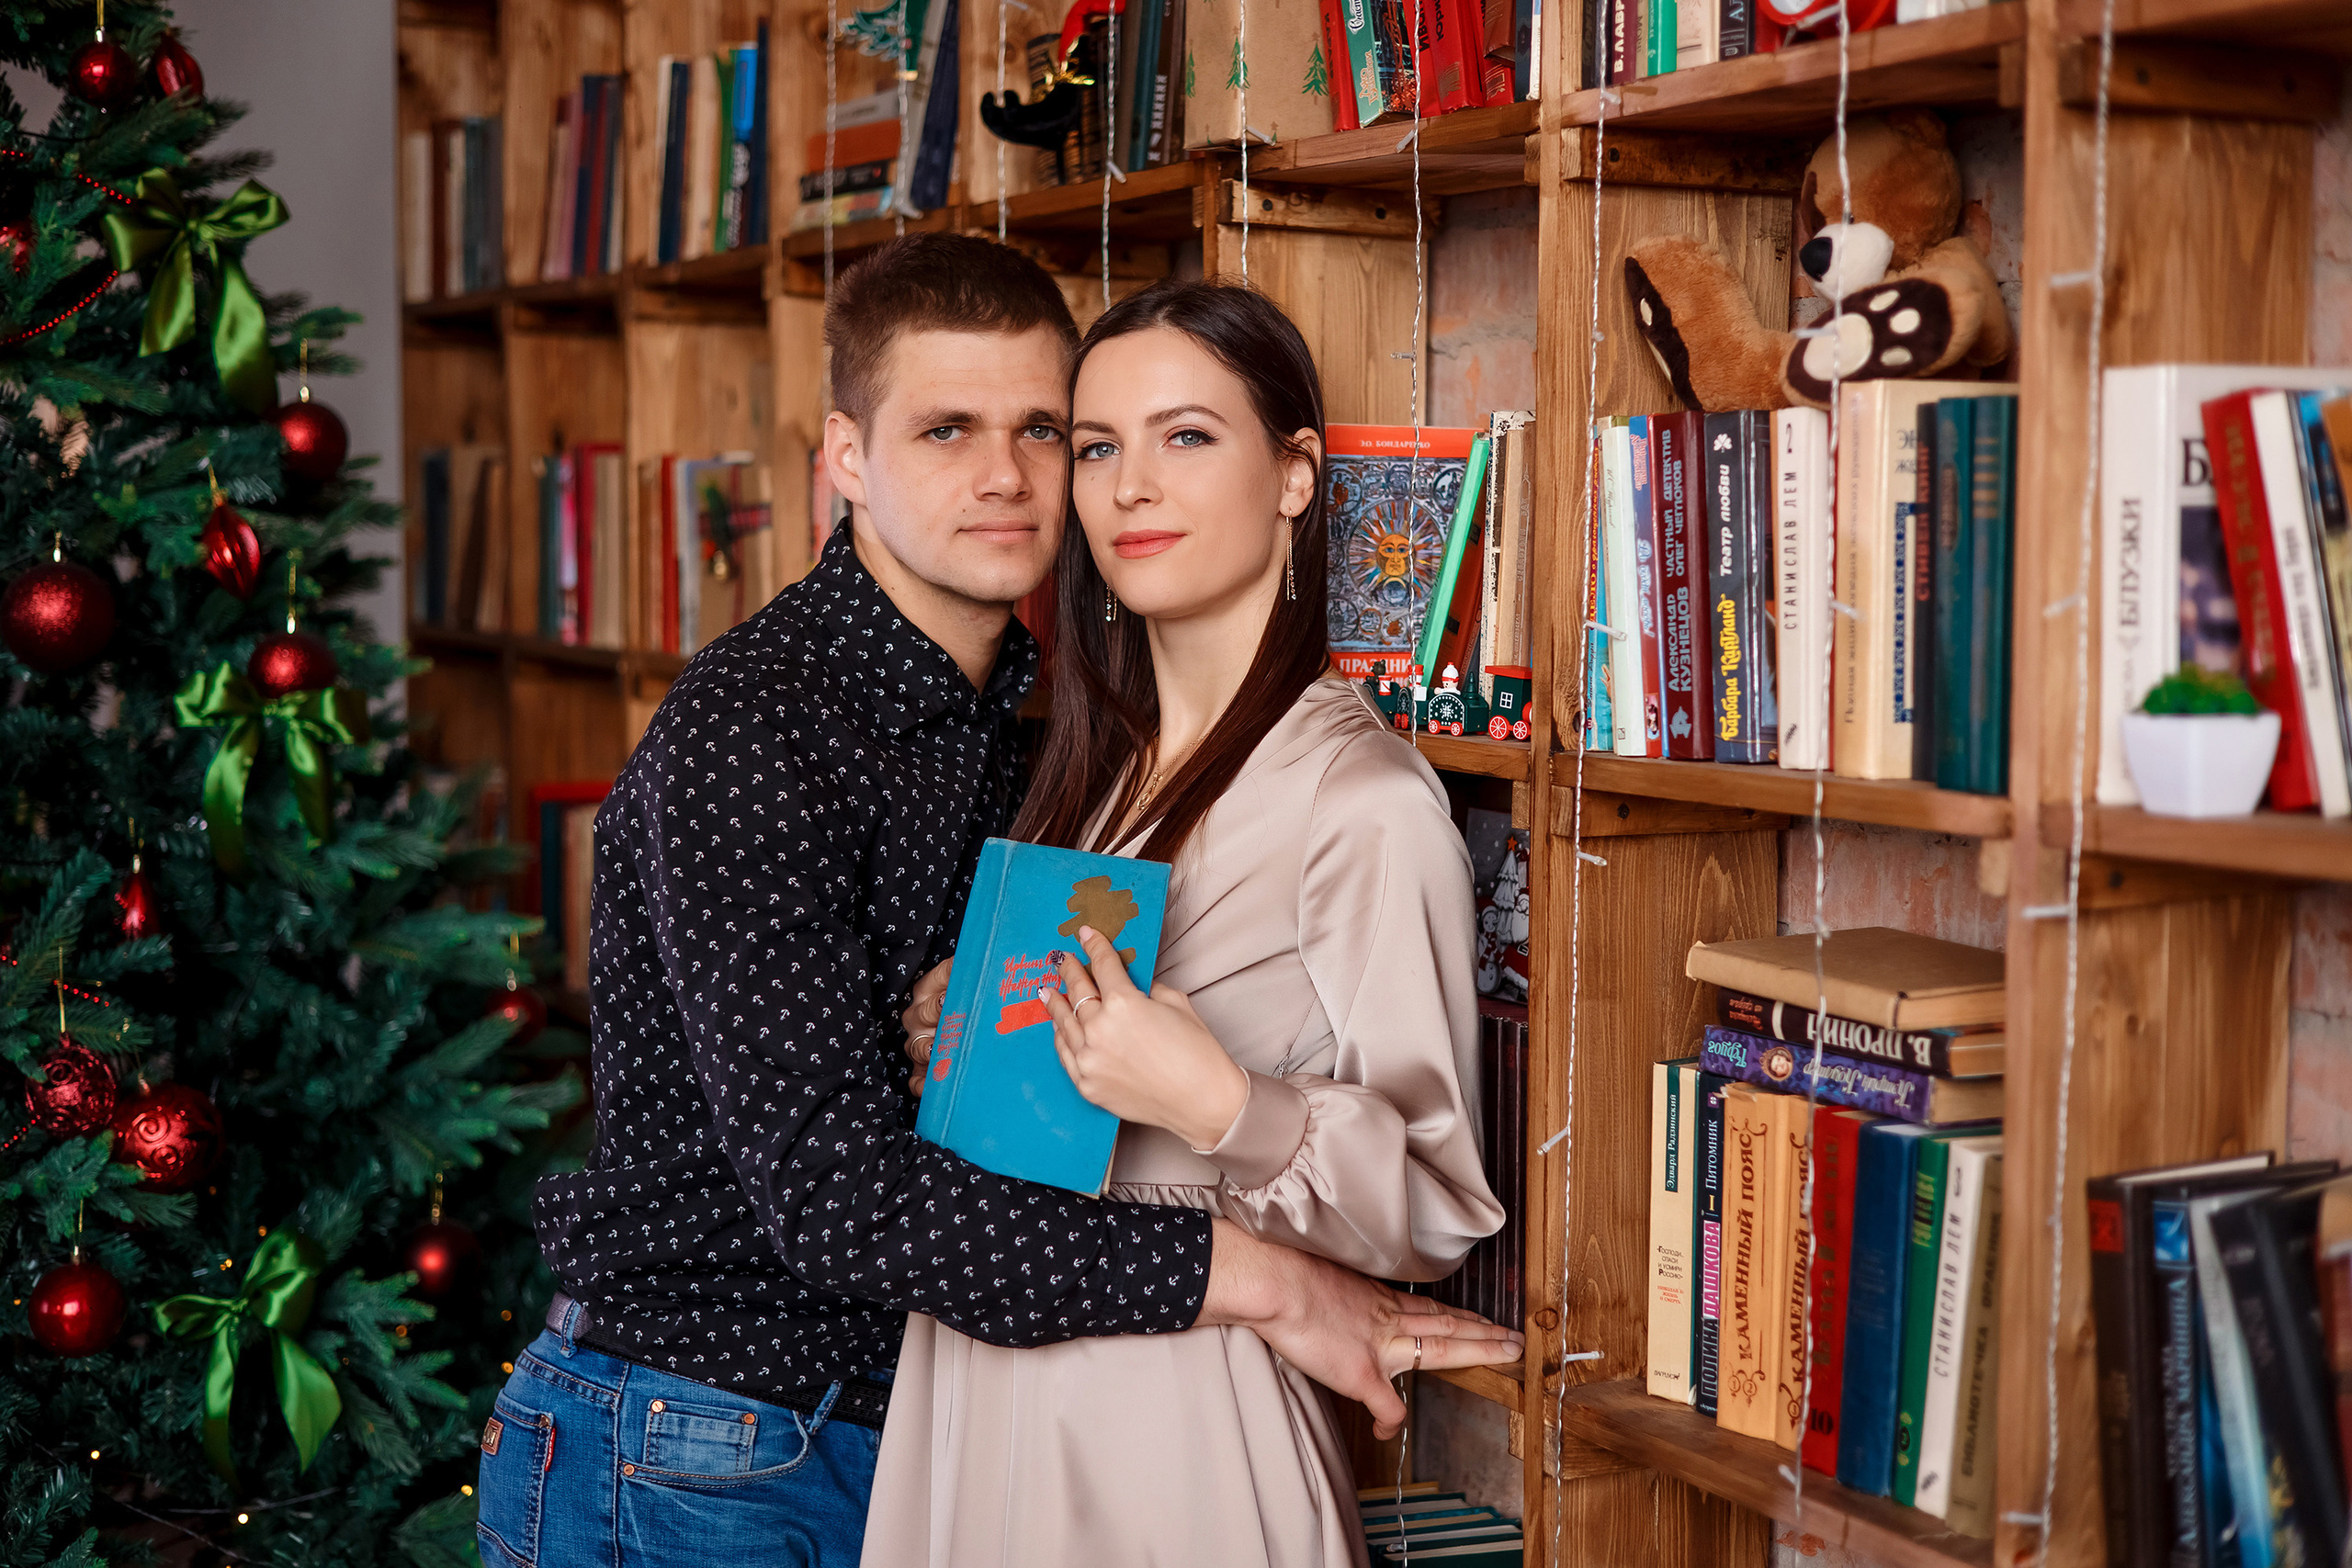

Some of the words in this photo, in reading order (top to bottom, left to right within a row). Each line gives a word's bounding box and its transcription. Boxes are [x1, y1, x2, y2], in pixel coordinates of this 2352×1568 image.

[1662, 429, 1673, 502] ДЕТЕКТИВ
[1673, 459, 1684, 535] ЧЕГЛОКОВ
[1718, 464, 1732, 522] любви
[1783, 471, 1798, 508] ЛЕМ
[1664, 509, 1674, 577] ЧАСТНЫЙ
[1674, 538, 1685, 577] ОЛЕГ
[1720, 526, 1734, 577] Театр
[1783, 521, 1798, 630] СТАНИСЛАВ
[2120, 497, 2143, 628] БЛУЗКИ
[1677, 586, 1692, 692] КУЗНЕЦОВ
[1716, 592, 1742, 677] Картланд
[1719, 677, 1742, 741] Барбара
[1707, 1040, 1747, 1069] Герцог
[1806, 1011, 1905, 1061] ПРОНИН
[1668, 1093, 1678, 1151] Радзинский
[1667, 1153, 1678, 1189] Эдвард
[1739, 1133, 1755, 1202] ПОЯС
[1702, 1220, 1721, 1319] ДАШКОВА
[1735, 1208, 1754, 1360] КАМЕННЫЙ
[1933, 1263, 1958, 1379] СТАНИСЛАВ
[1946, 1213, 1962, 1255] ЛЕМ
[1701, 1317, 1720, 1398] ПОЛИНА
